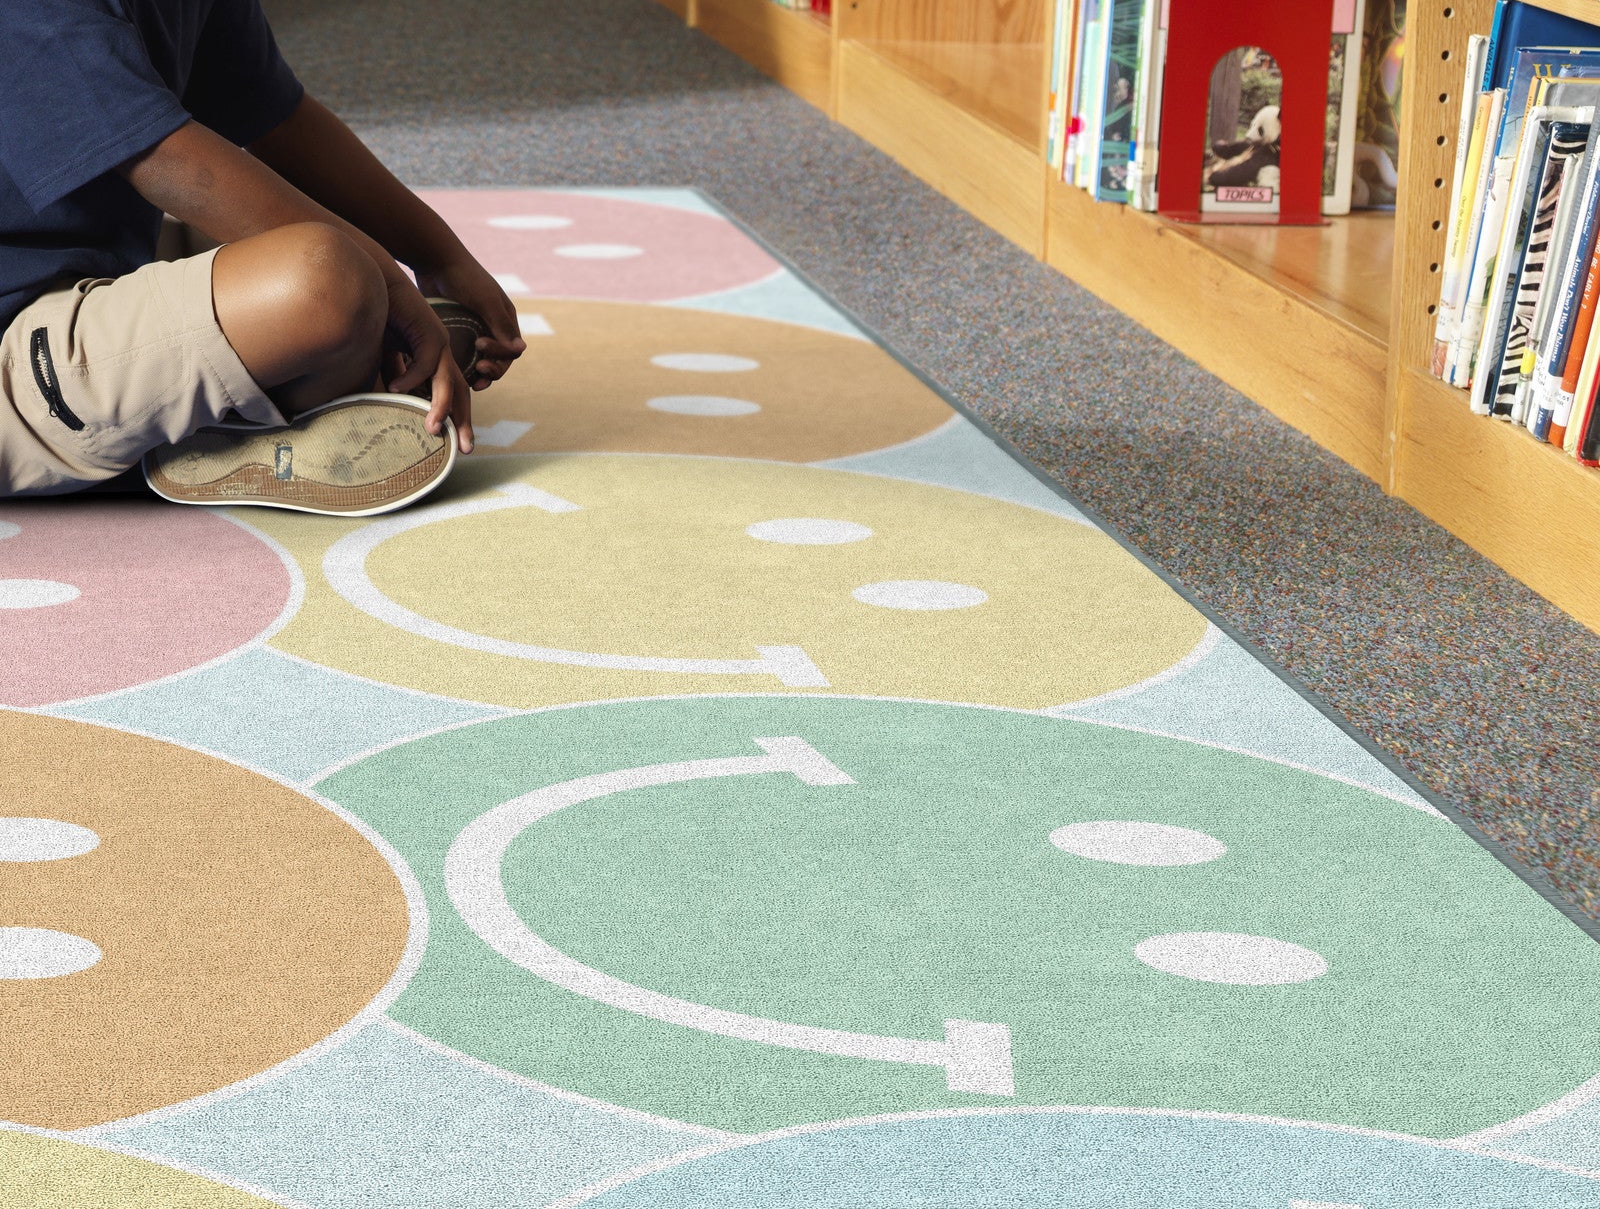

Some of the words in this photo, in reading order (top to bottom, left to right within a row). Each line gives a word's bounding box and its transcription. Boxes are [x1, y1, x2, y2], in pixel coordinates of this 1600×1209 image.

[1483, 38, 1496, 82] ANIMALS
[1225, 189, 1264, 200] TOPICS
[1451, 238, 1460, 258] Swamp
[1570, 255, 1581, 289] Animals
[1591, 257, 1597, 269] BE
[1584, 272, 1594, 302] EARLY
[1564, 289, 1574, 311] Don't
[1558, 312, 1568, 332] Wear
[1551, 331, 1562, 362] Pajamas
